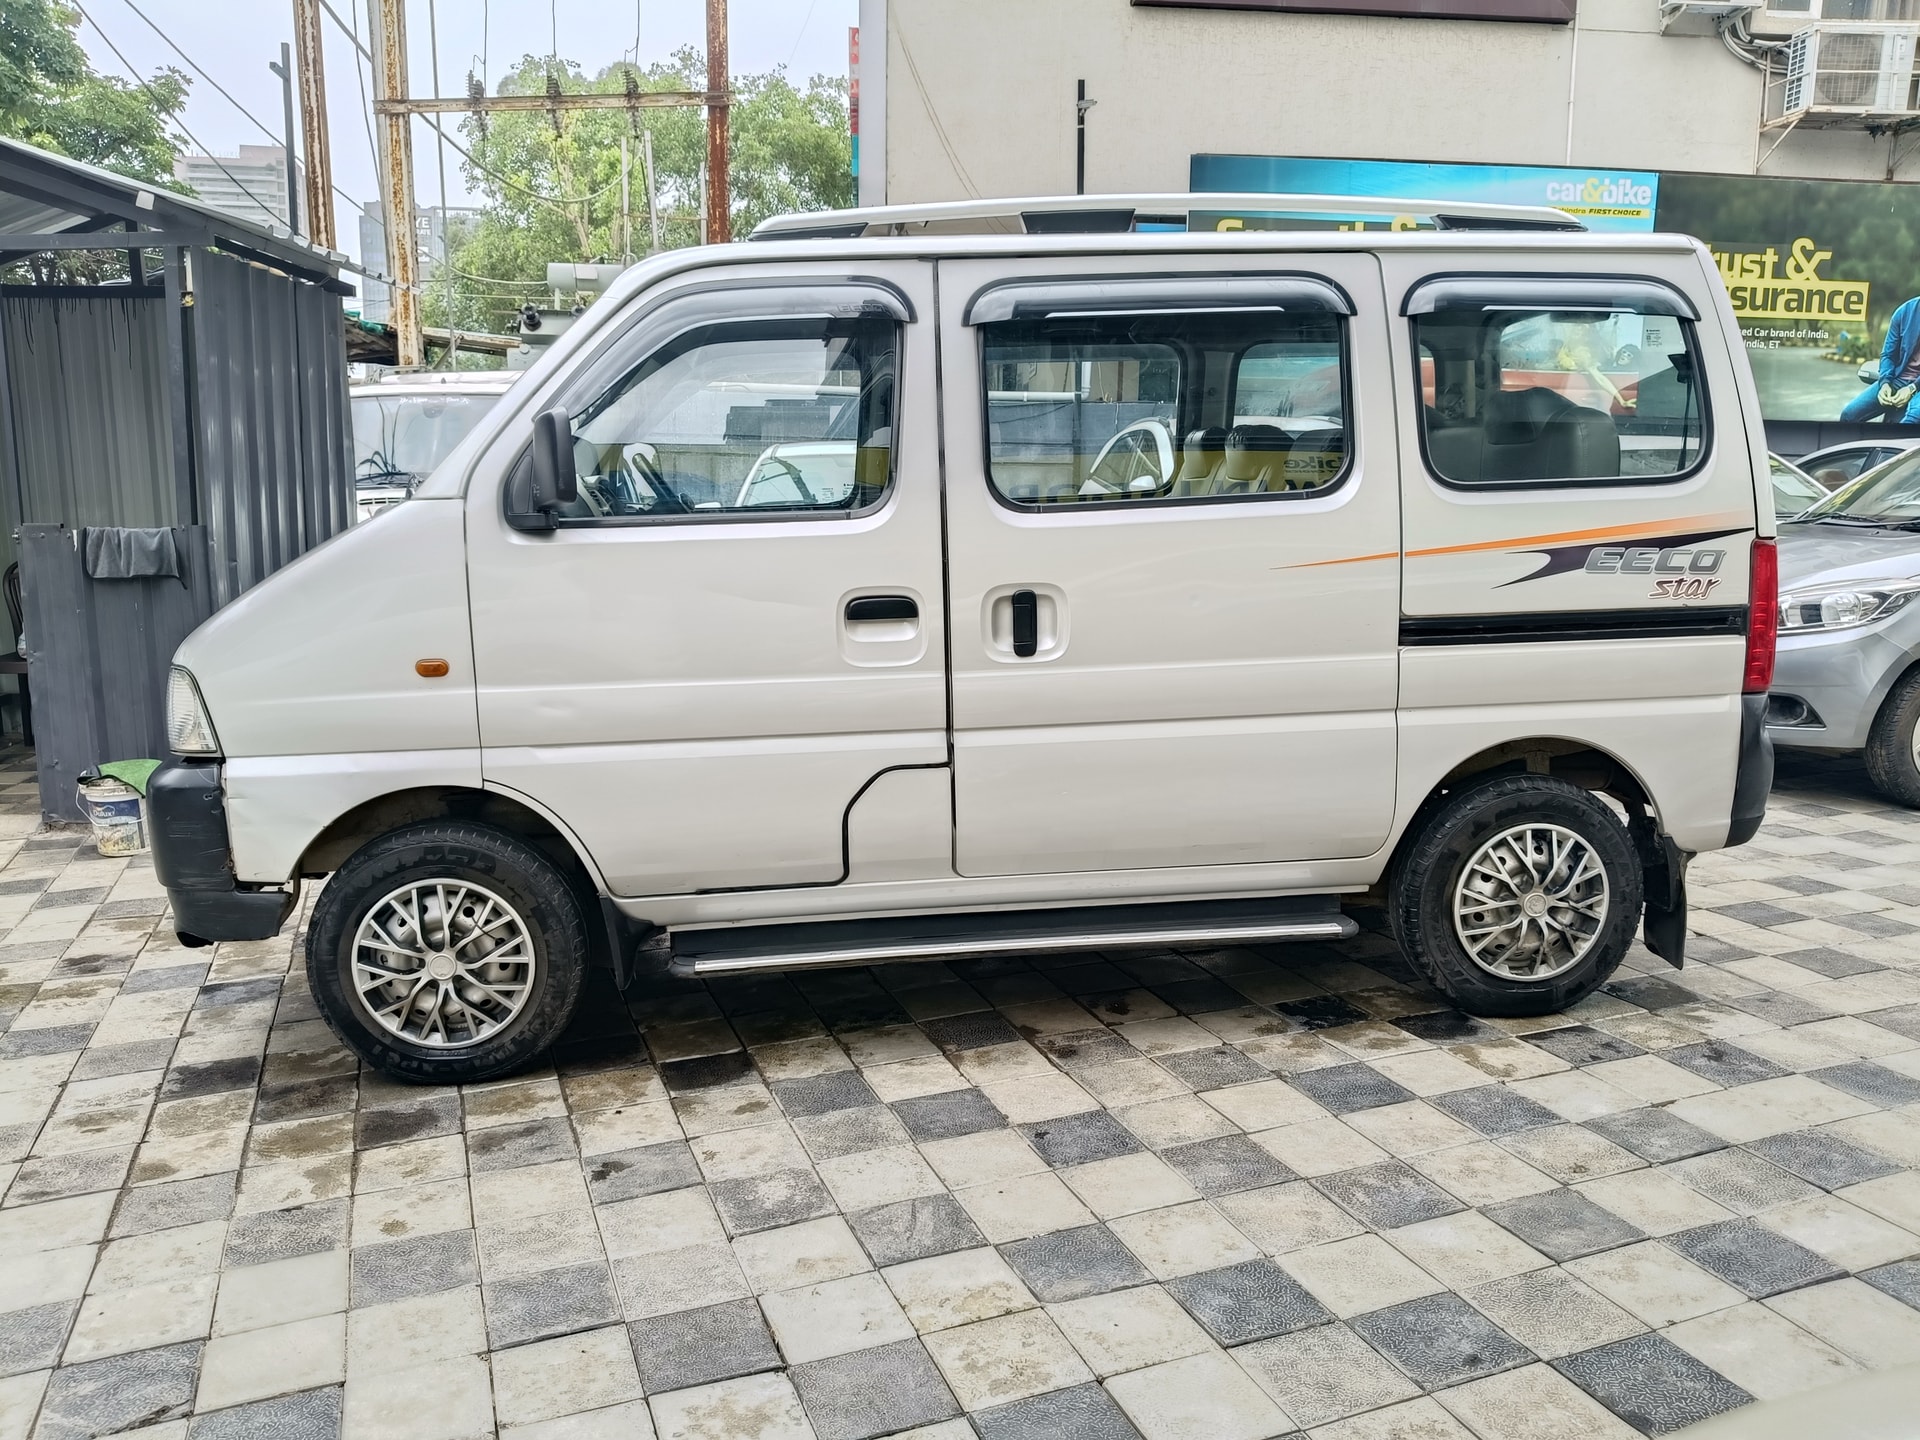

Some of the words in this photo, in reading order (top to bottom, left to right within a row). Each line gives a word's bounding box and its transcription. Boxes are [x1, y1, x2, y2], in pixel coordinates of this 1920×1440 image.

[1546, 177, 1652, 205] car&bike
[1786, 237, 1832, 281] &
[1726, 284, 1864, 315] surance
[1740, 327, 1753, 337] ed
[1754, 328, 1768, 337] Car
[1770, 328, 1795, 338] brand
[1796, 329, 1807, 338] of
[1807, 330, 1829, 339] India
[1769, 340, 1781, 349] ET
[1585, 547, 1727, 574] EECO
[1649, 577, 1721, 600] star
